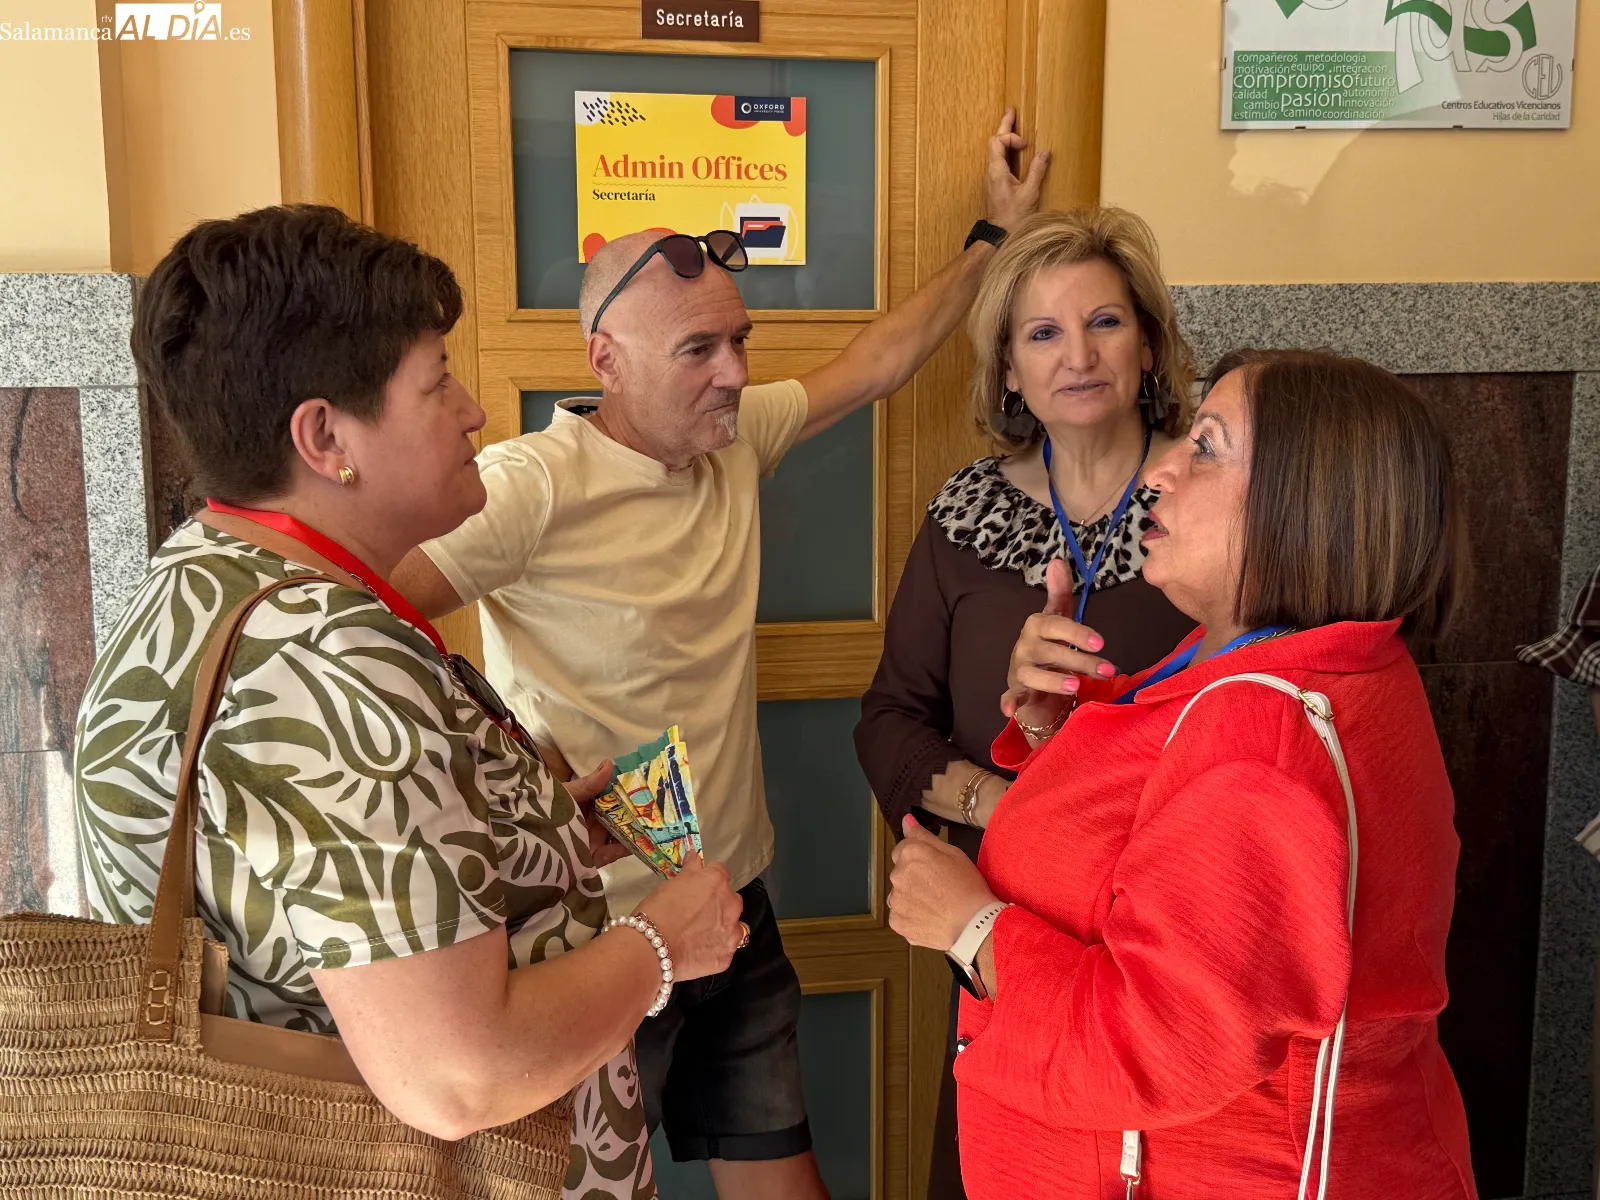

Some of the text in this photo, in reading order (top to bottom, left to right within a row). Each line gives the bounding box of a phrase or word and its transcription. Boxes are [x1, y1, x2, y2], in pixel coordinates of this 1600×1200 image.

[656, 9, 744, 28] Secretaría
[1237, 52, 1366, 65] compañeros metodología
[1234, 62, 1388, 75] motivación equipo integración
[1233, 69, 1395, 93] compromiso futuro
[1232, 89, 1267, 100] calidad
[1281, 87, 1342, 112] pasión
[1243, 100, 1280, 110] cambio
[1342, 98, 1395, 108] innovación
[1441, 101, 1561, 110] Centros Educativos Vicencianos
[1283, 107, 1322, 118] camino
[1322, 108, 1385, 119] coordinación
[1512, 112, 1523, 121] de
[592, 154, 788, 181] Admin Offices
[592, 188, 656, 202] Secretaría
